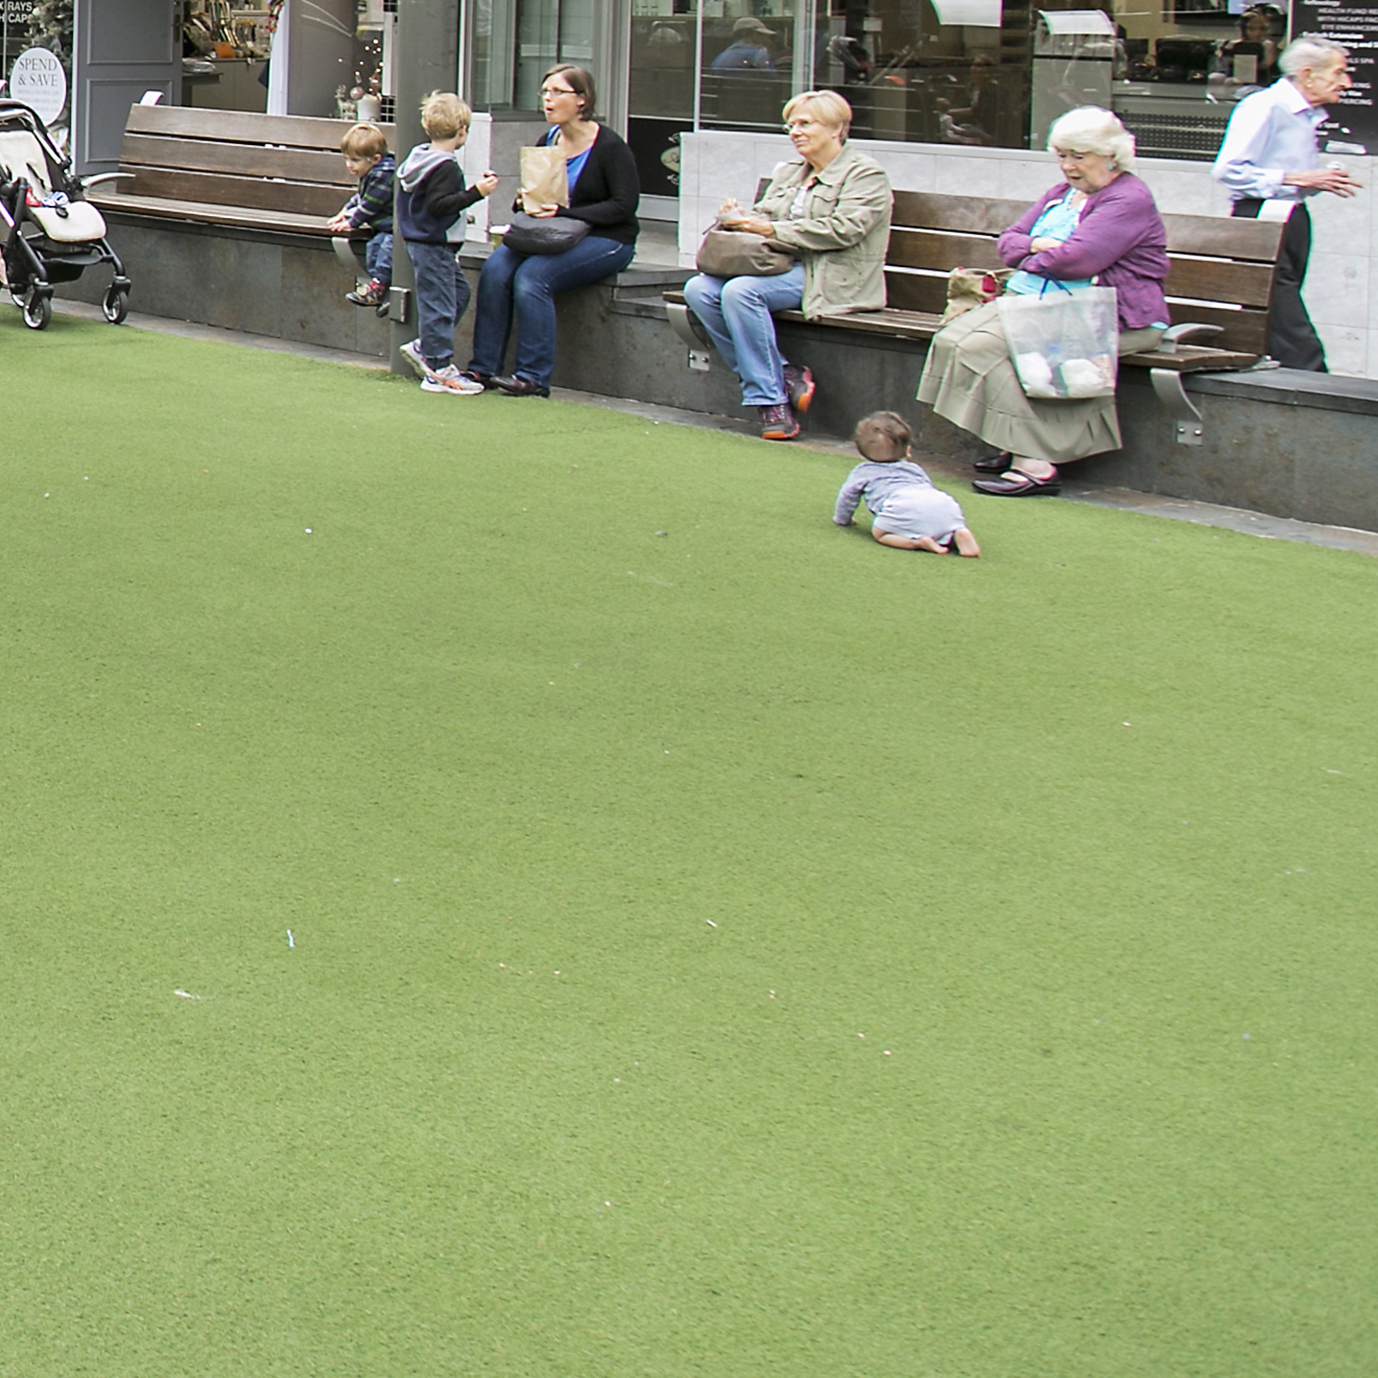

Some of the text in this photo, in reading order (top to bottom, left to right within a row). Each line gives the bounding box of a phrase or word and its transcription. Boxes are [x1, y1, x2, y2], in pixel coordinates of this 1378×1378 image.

[18, 57, 58, 71] SPEND
[18, 73, 58, 87] & SAVE
